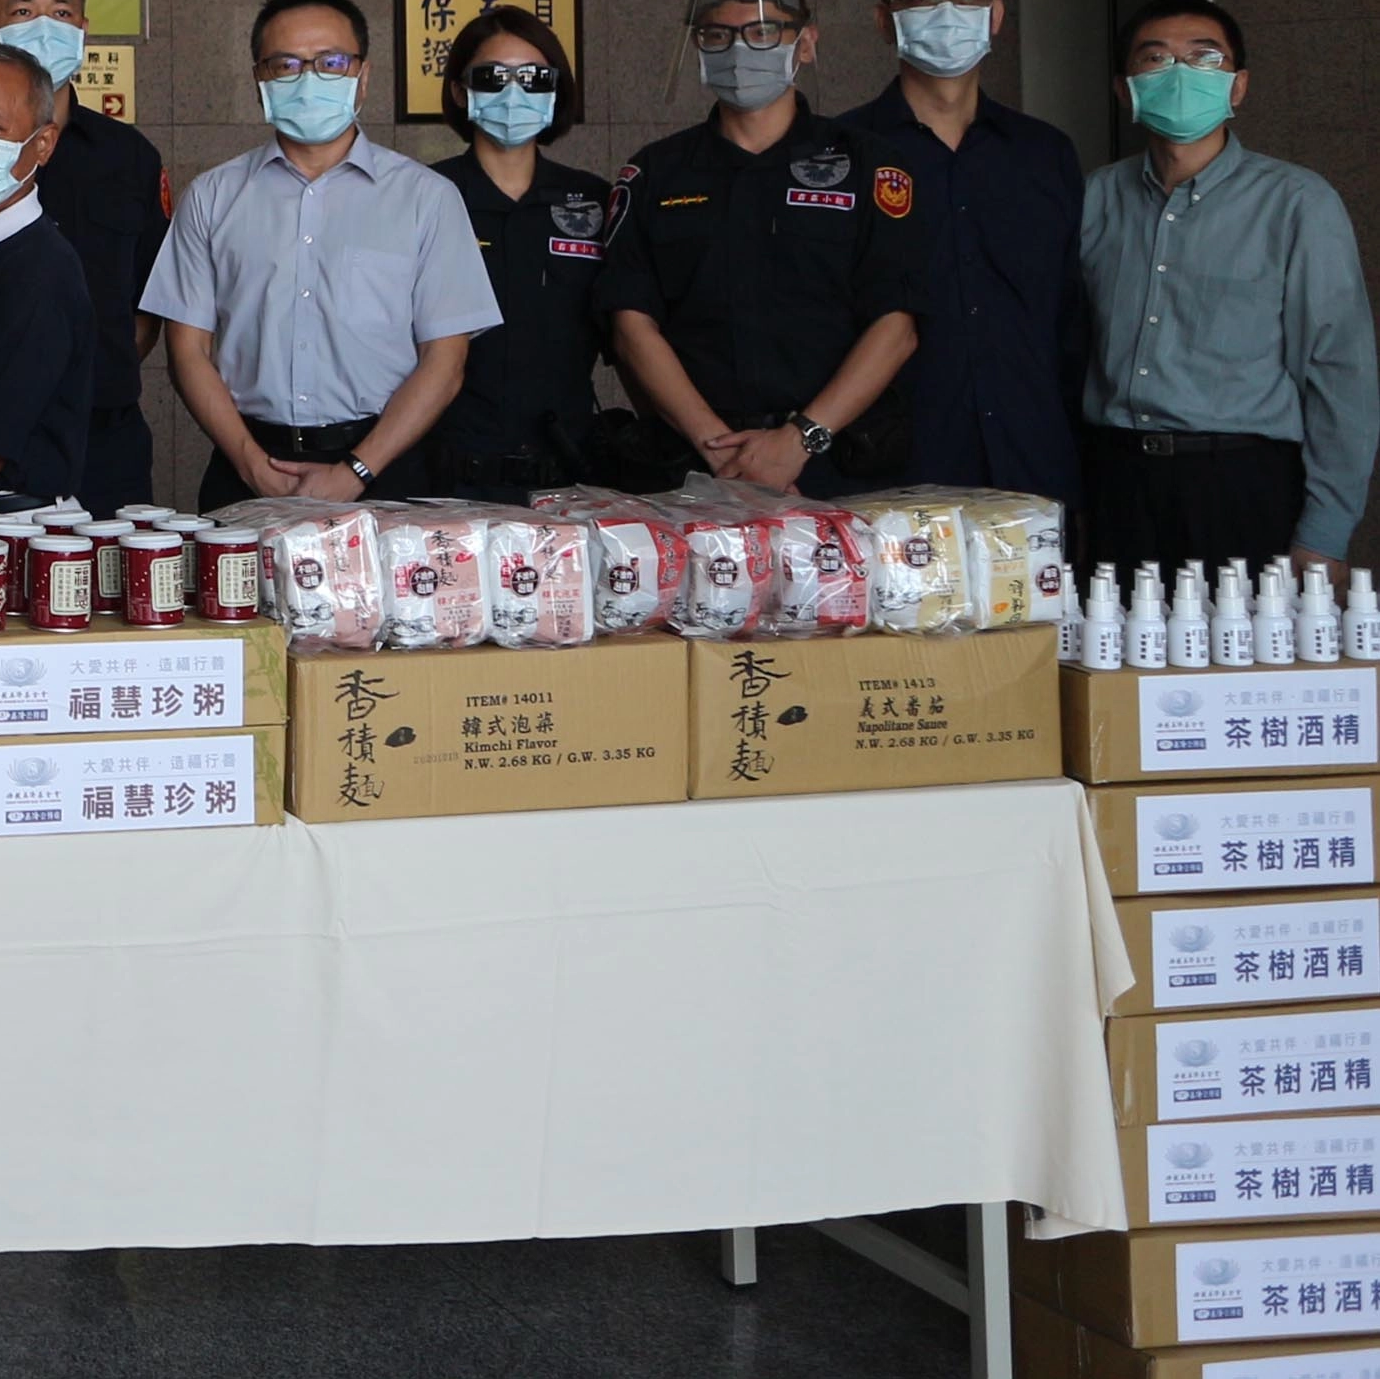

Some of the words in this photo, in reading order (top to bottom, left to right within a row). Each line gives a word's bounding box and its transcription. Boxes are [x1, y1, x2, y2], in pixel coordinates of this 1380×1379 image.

[859, 679, 899, 691] ITEM#
[903, 677, 936, 689] 1413
[68, 683, 225, 721] 福慧珍粥
[466, 695, 508, 707] ITEM#
[514, 692, 554, 705] 14011
[461, 713, 555, 738] 韓式泡菜
[856, 737, 884, 750] N.W.
[888, 736, 915, 748] 2.68
[919, 735, 938, 747] KG
[953, 733, 982, 745] G.W.
[986, 731, 1013, 742] 3.35
[1017, 728, 1035, 740] KG
[857, 720, 914, 734] Napolitane
[917, 718, 948, 731] Sauce
[1224, 714, 1360, 749] 茶樹酒精
[464, 757, 494, 770] N.W.
[499, 756, 527, 768] 2.68
[532, 754, 552, 767] KG
[556, 753, 563, 766] /
[567, 751, 597, 764] G.W.
[602, 749, 632, 762] 3.35
[636, 747, 656, 760] KG
[465, 739, 513, 753] Kimchi
[517, 738, 558, 751] Flavor
[82, 781, 236, 820] 福慧珍粥
[1221, 836, 1356, 872] 茶樹酒精
[1234, 945, 1364, 983] 茶樹酒精
[1239, 1058, 1372, 1096] 茶樹酒精
[1234, 1163, 1375, 1200] 茶樹酒精
